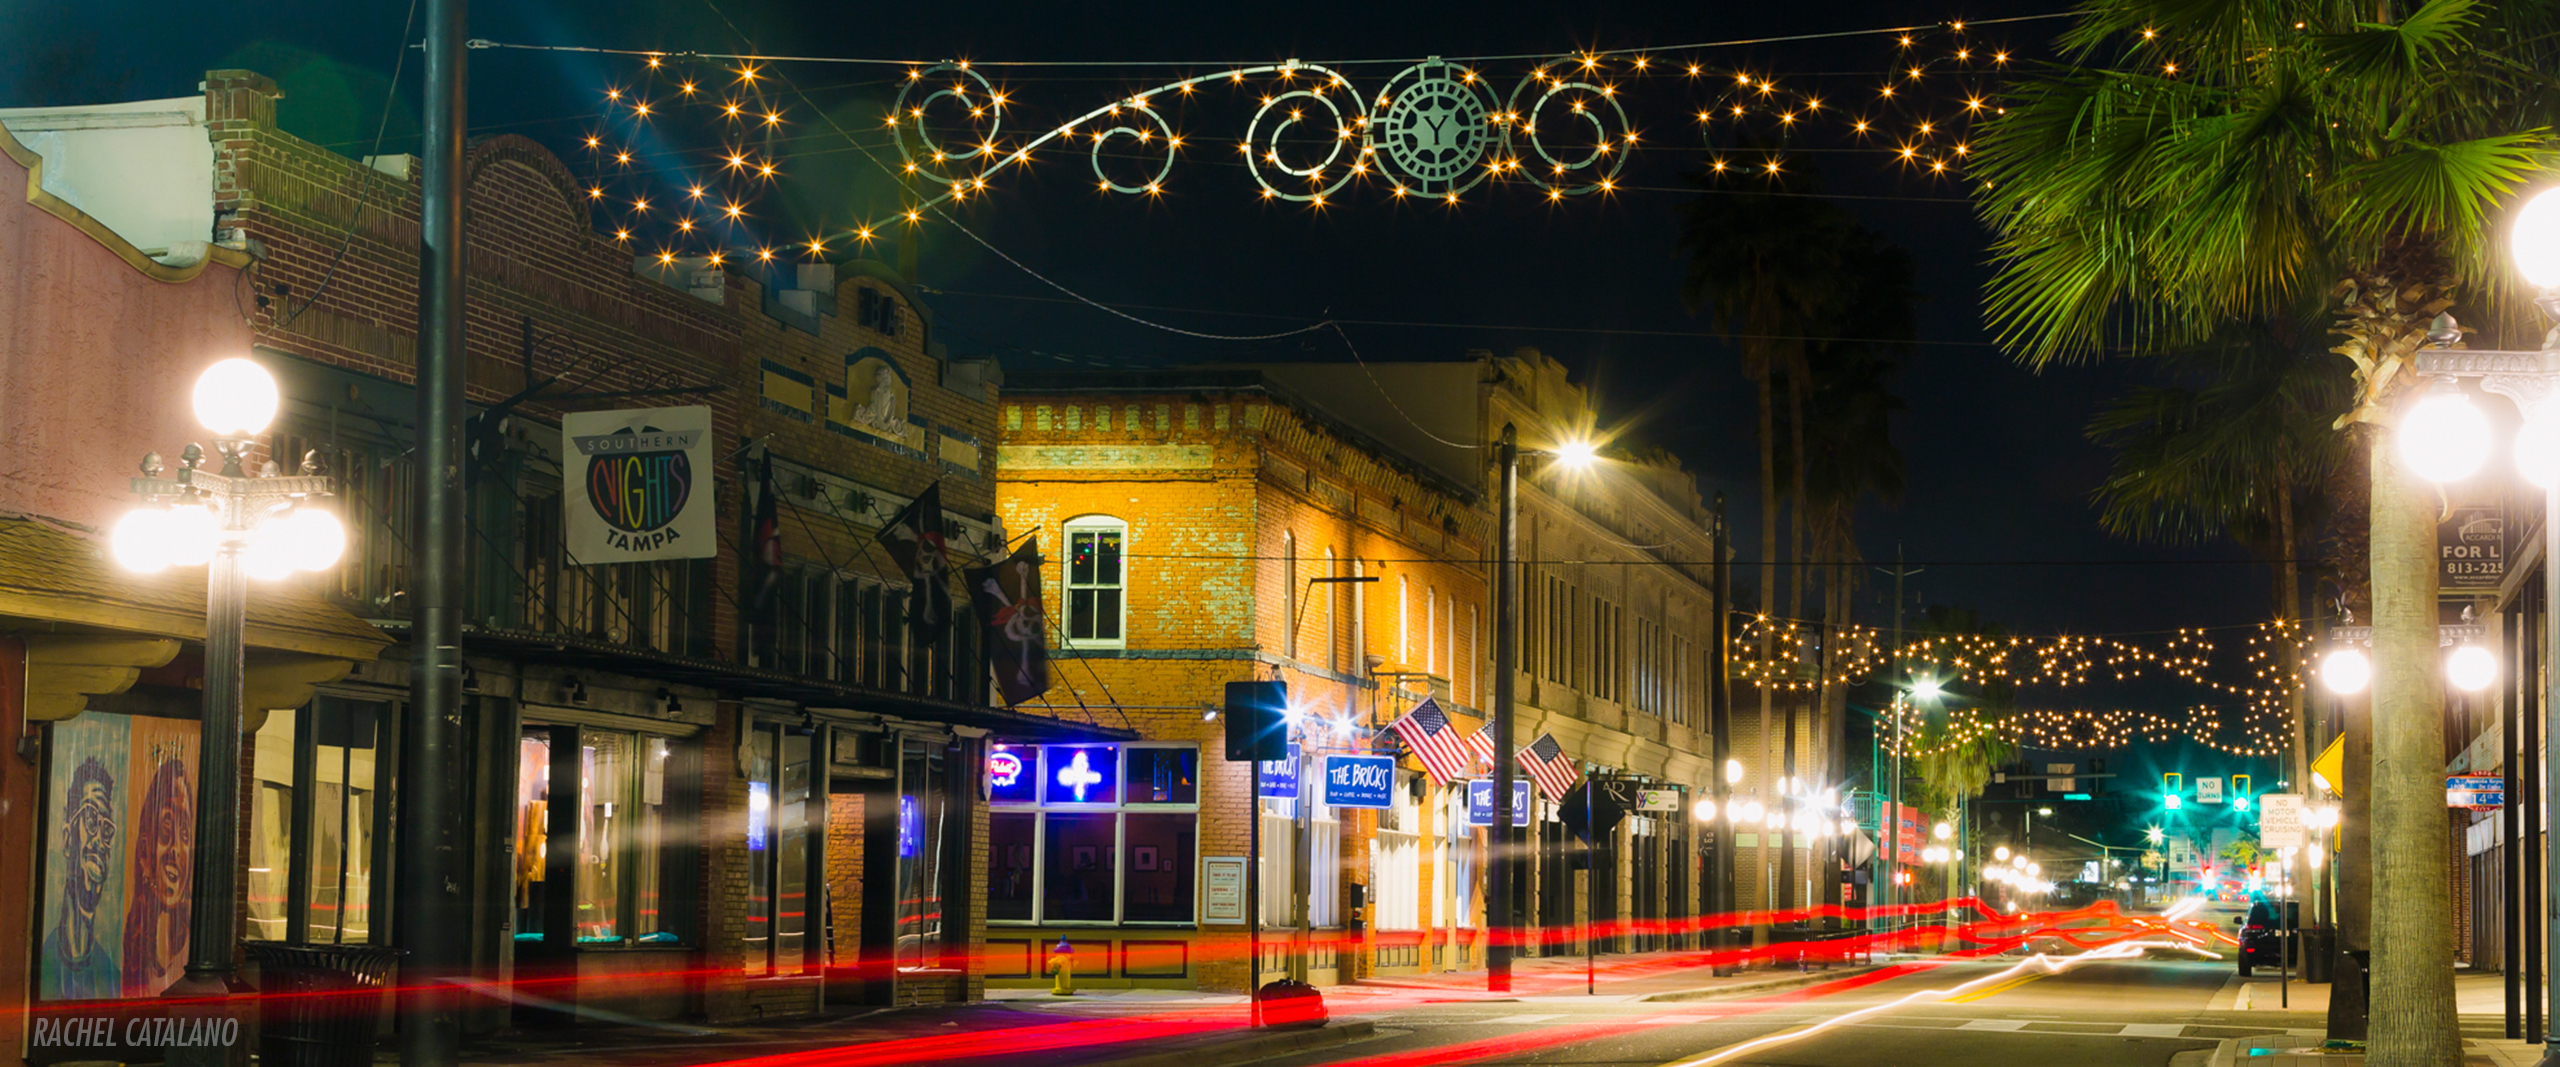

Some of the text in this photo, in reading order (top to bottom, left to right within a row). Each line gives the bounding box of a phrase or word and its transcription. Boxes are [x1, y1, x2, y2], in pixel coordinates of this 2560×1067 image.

[1423, 114, 1449, 146] Y
[587, 434, 689, 451] SOUTHERN
[592, 453, 686, 529] NIGHTS
[605, 526, 681, 552] TAMPA
[2465, 533, 2496, 541] ACCARDI
[2442, 545, 2482, 559] FOR
[1330, 763, 1389, 791] THE BRICKS
[2202, 780, 2215, 789] NO
[1473, 788, 1492, 807] THE
[2275, 799, 2288, 807] NO
[2268, 808, 2297, 816] MOTOR
[2265, 816, 2299, 825] VEHICLE
[2264, 825, 2302, 834] CRUISING
